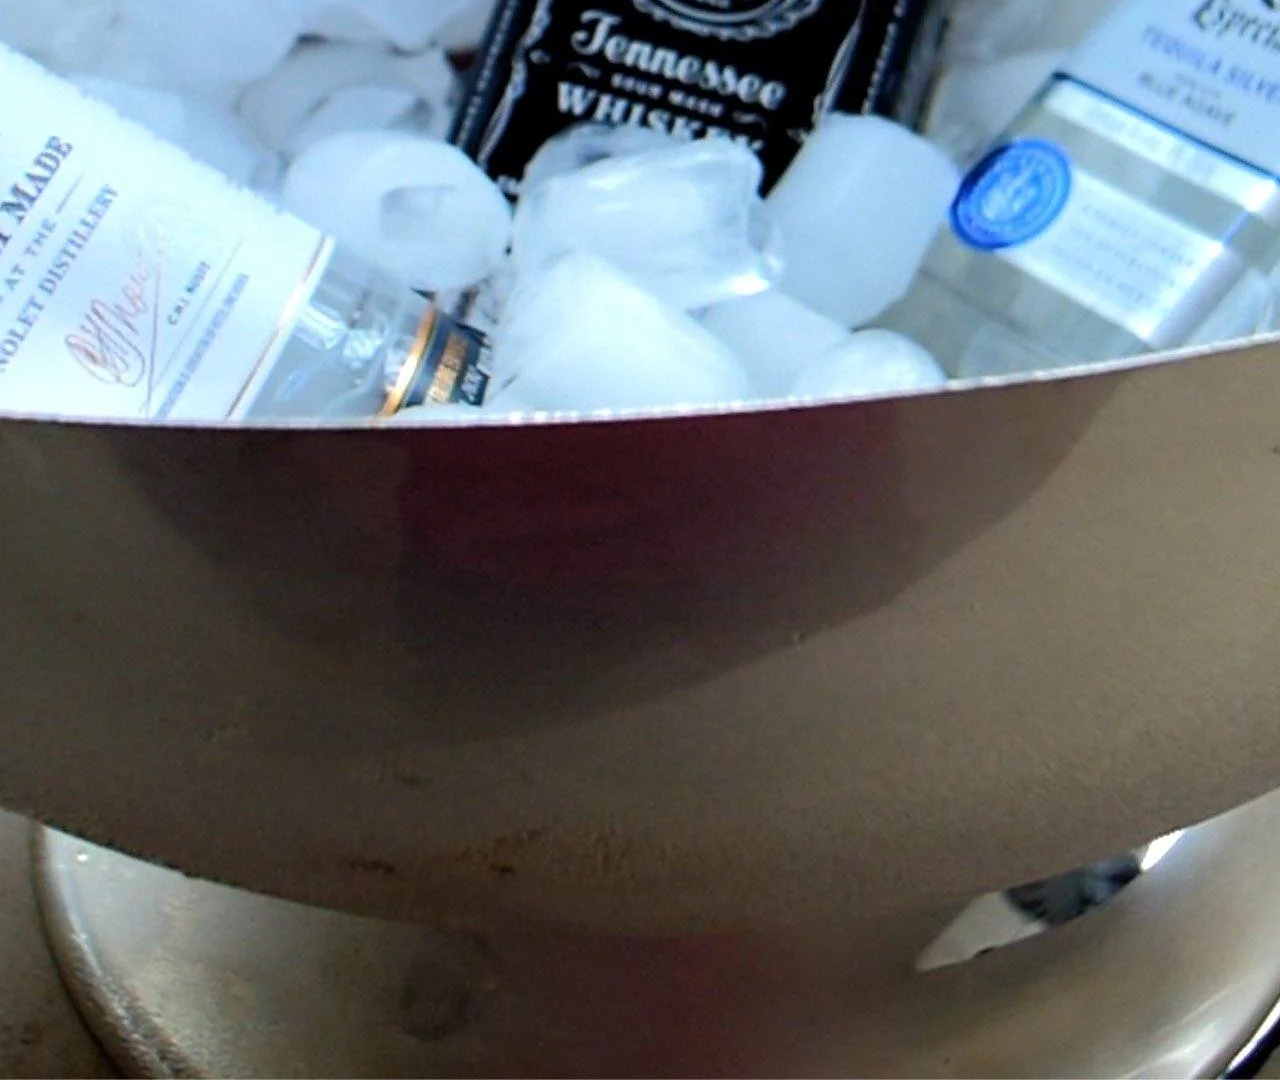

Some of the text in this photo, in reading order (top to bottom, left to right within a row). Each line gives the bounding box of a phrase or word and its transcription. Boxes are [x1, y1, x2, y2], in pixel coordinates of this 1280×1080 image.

[570, 9, 787, 110] Tennessee
[1141, 24, 1223, 76] TEQUILA
[4, 218, 58, 292] AT THE
[37, 183, 120, 298] DISTILLERY
